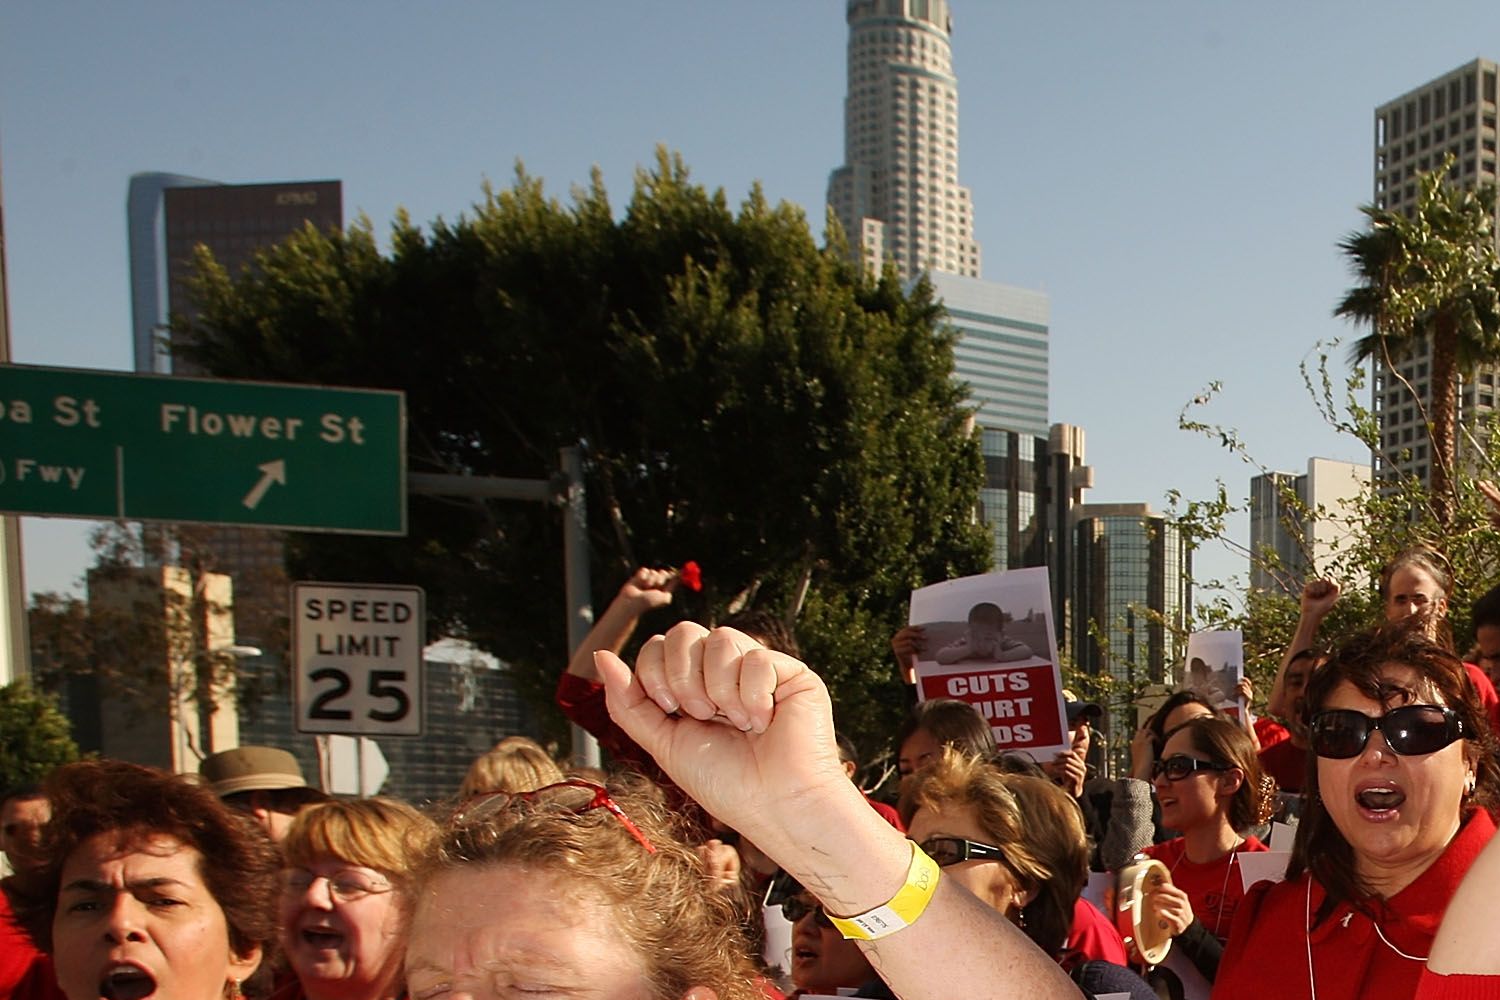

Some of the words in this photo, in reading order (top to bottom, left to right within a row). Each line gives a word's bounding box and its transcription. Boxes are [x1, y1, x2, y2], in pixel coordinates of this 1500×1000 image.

[54, 396, 101, 427] St
[160, 404, 303, 440] Flower
[320, 414, 365, 444] St
[16, 460, 86, 490] Fwy
[305, 599, 411, 623] SPEED
[317, 634, 401, 657] LIMIT
[307, 668, 411, 722] 25
[947, 672, 1029, 696] CUTS
[972, 698, 1033, 719] URT
